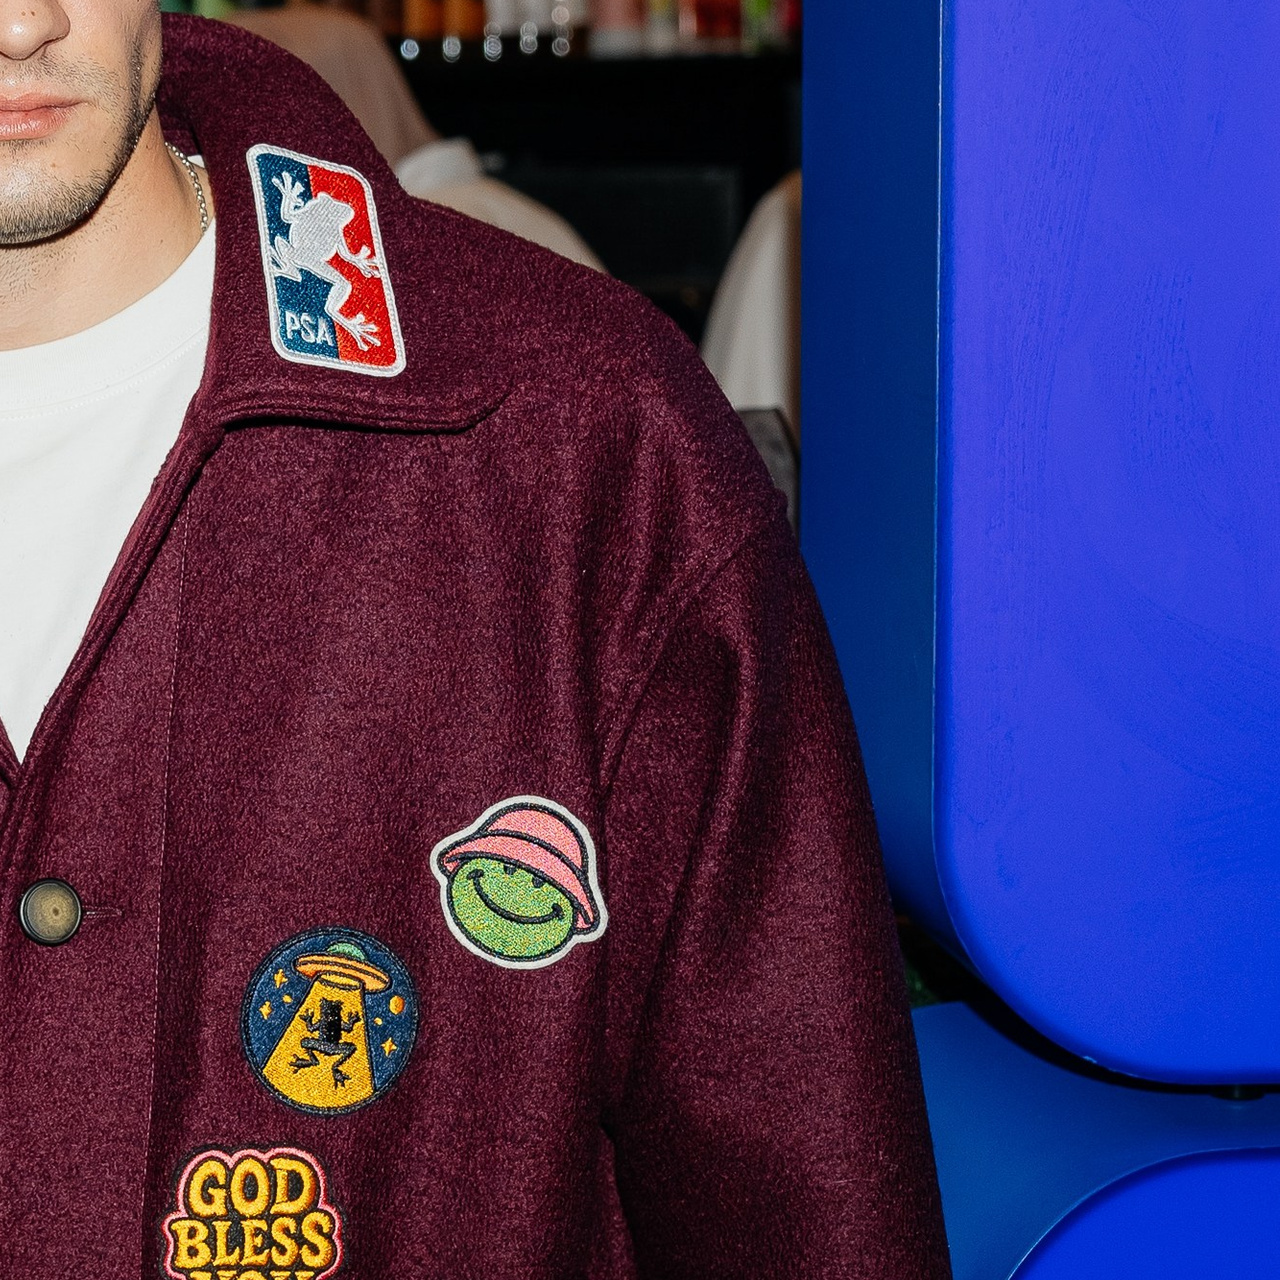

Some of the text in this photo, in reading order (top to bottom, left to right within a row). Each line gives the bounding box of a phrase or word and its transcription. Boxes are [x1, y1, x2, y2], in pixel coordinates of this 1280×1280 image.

[284, 310, 335, 347] PSA
[188, 1157, 317, 1217] GOD
[170, 1211, 334, 1268] BLESS
